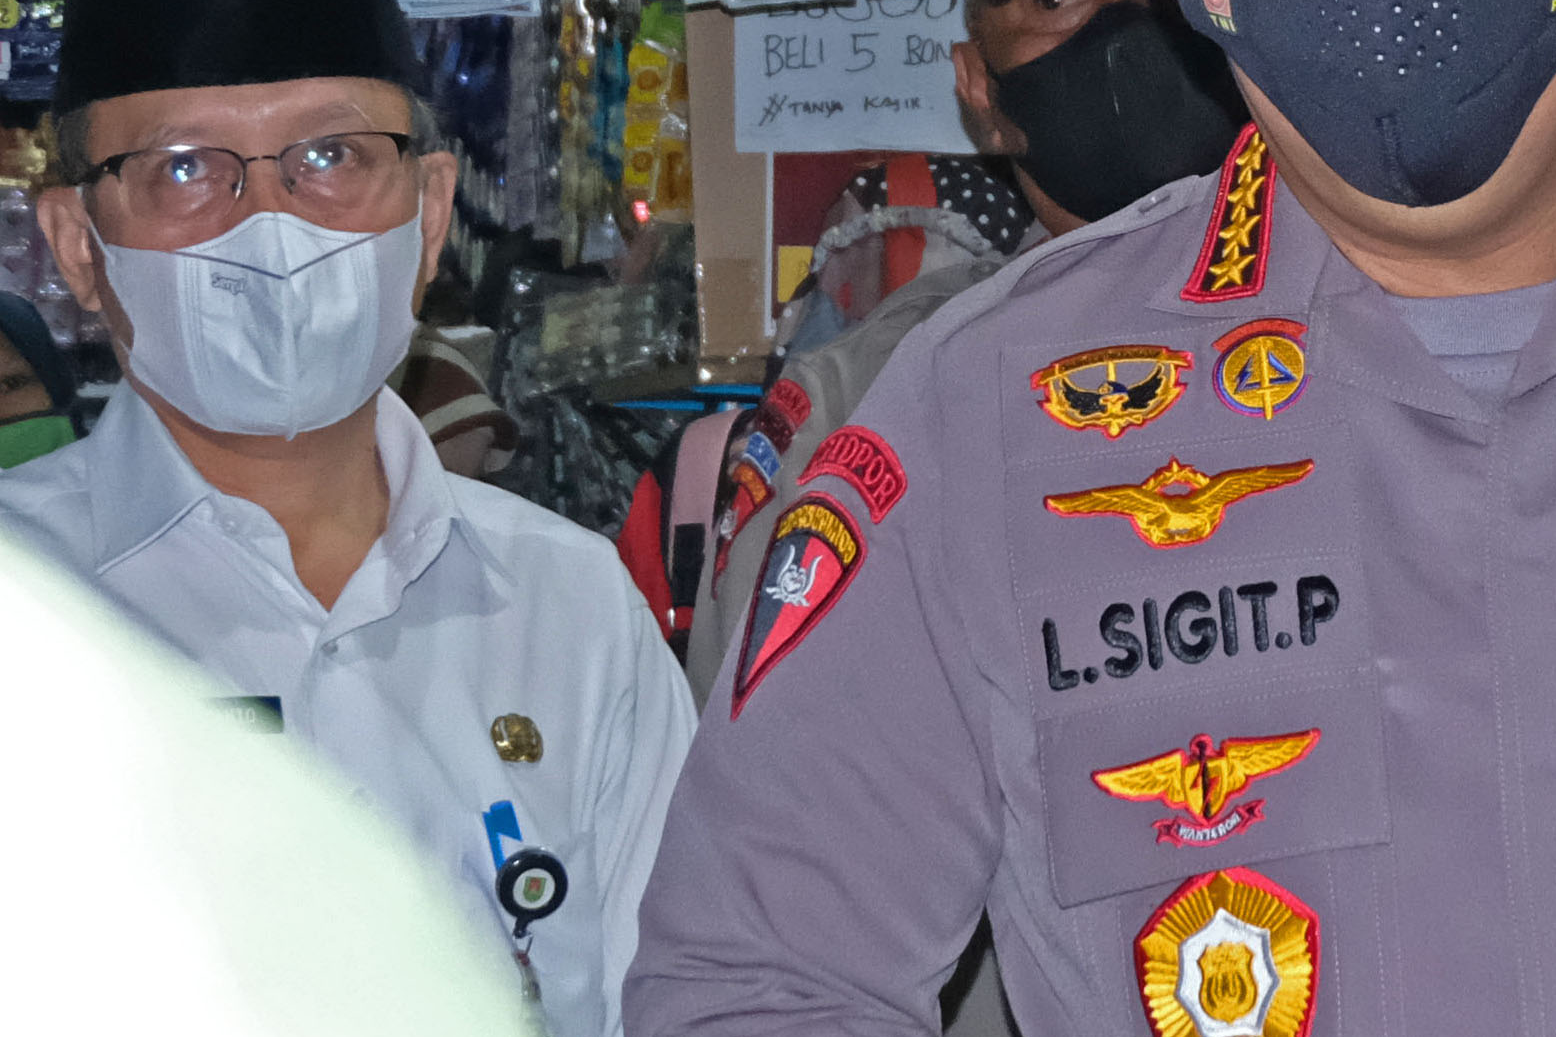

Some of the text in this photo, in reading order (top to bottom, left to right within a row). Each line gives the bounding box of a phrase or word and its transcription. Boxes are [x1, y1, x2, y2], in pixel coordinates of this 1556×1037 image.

[764, 34, 823, 77] BELI
[845, 32, 879, 72] 5
[788, 100, 843, 118] TANYA
[1042, 574, 1340, 691] L.SIGIT.P
